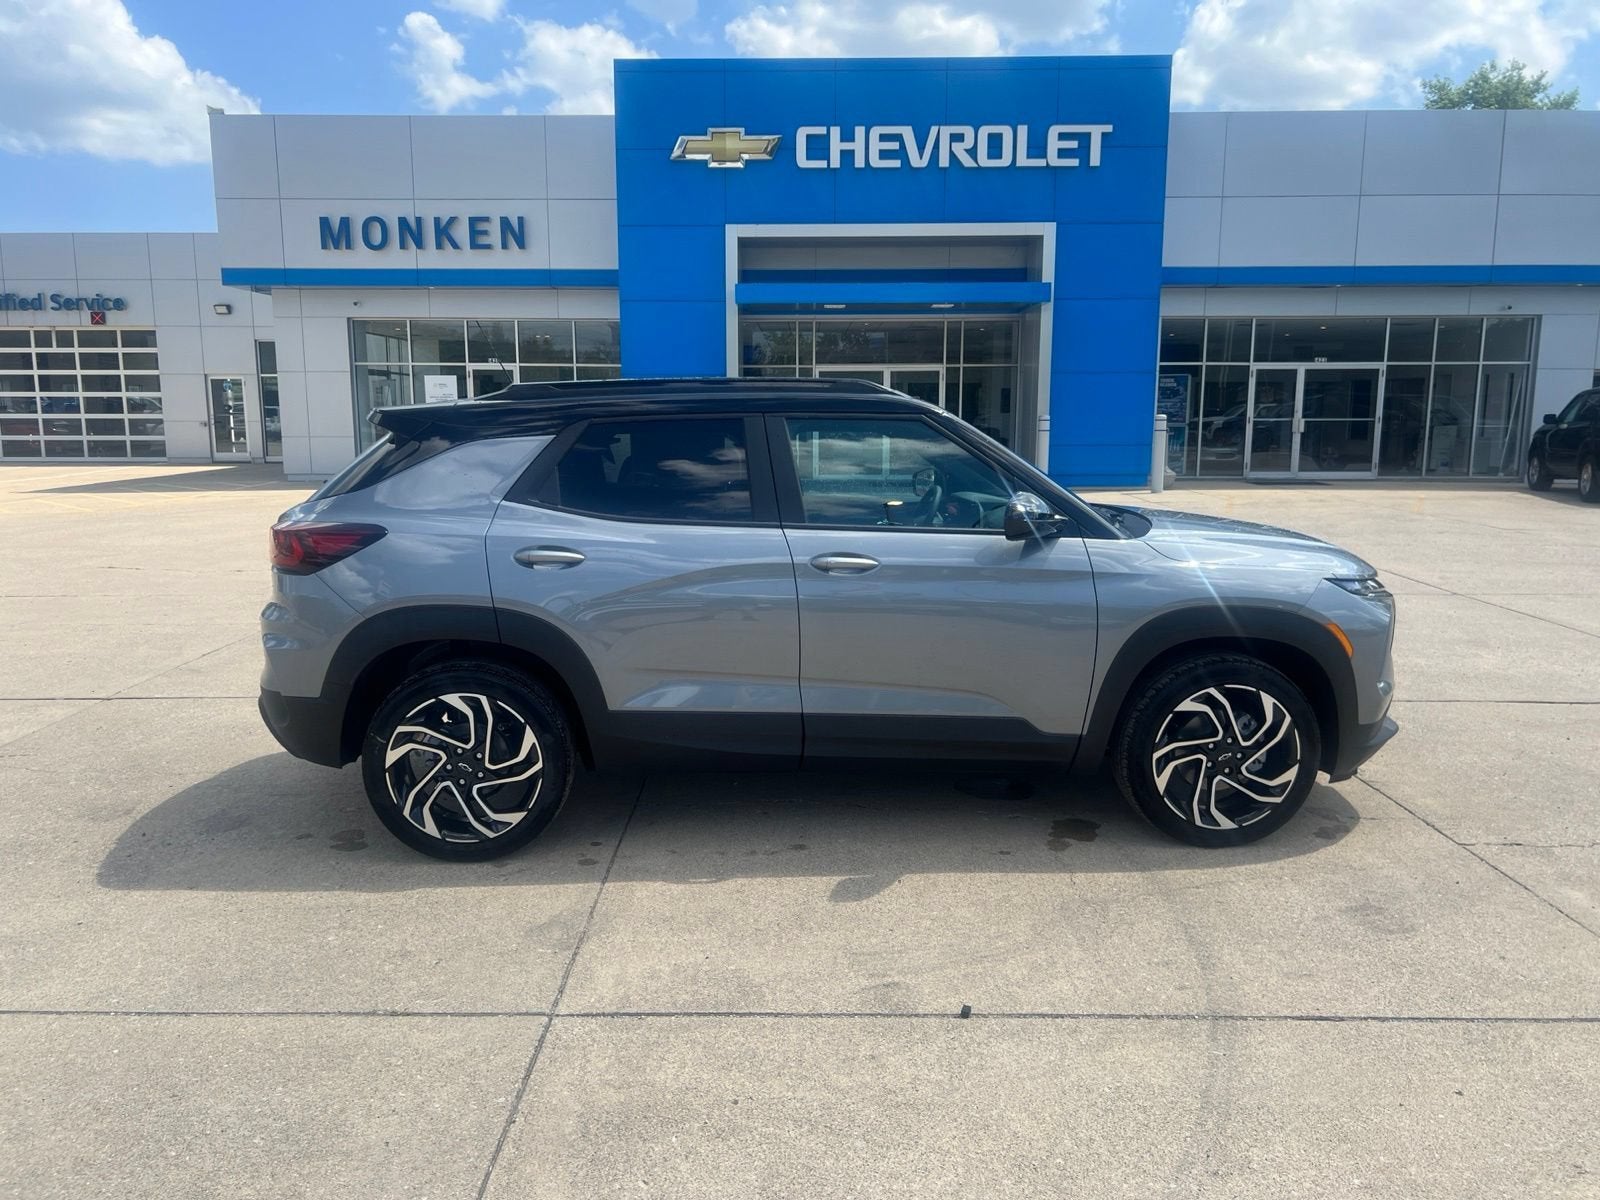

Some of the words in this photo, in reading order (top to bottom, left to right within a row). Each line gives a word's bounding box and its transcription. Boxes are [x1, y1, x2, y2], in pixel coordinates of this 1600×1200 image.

[796, 124, 1114, 169] CHEVROLET
[319, 215, 527, 251] MONKEN
[50, 293, 126, 311] Service
